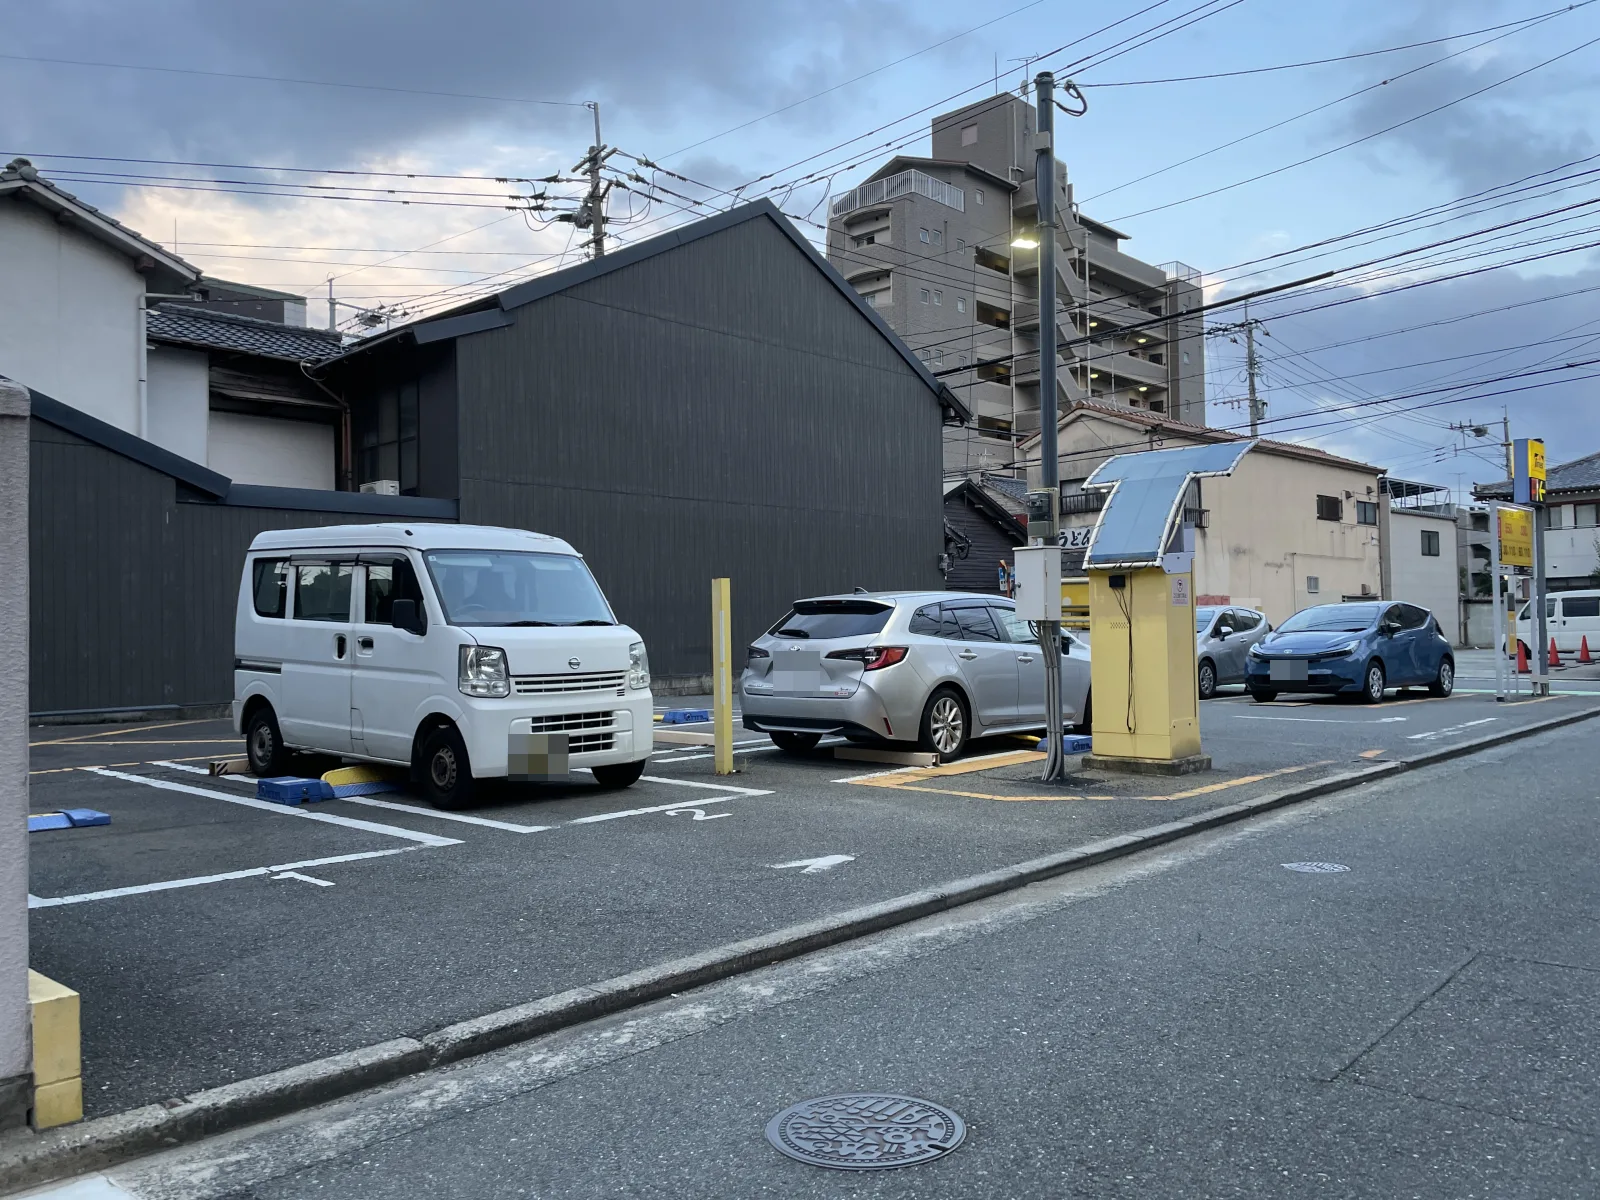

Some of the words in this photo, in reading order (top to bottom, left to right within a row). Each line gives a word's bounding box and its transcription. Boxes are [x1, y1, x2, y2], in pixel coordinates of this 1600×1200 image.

[1059, 529, 1091, 548] うどん
[665, 809, 734, 821] 2
